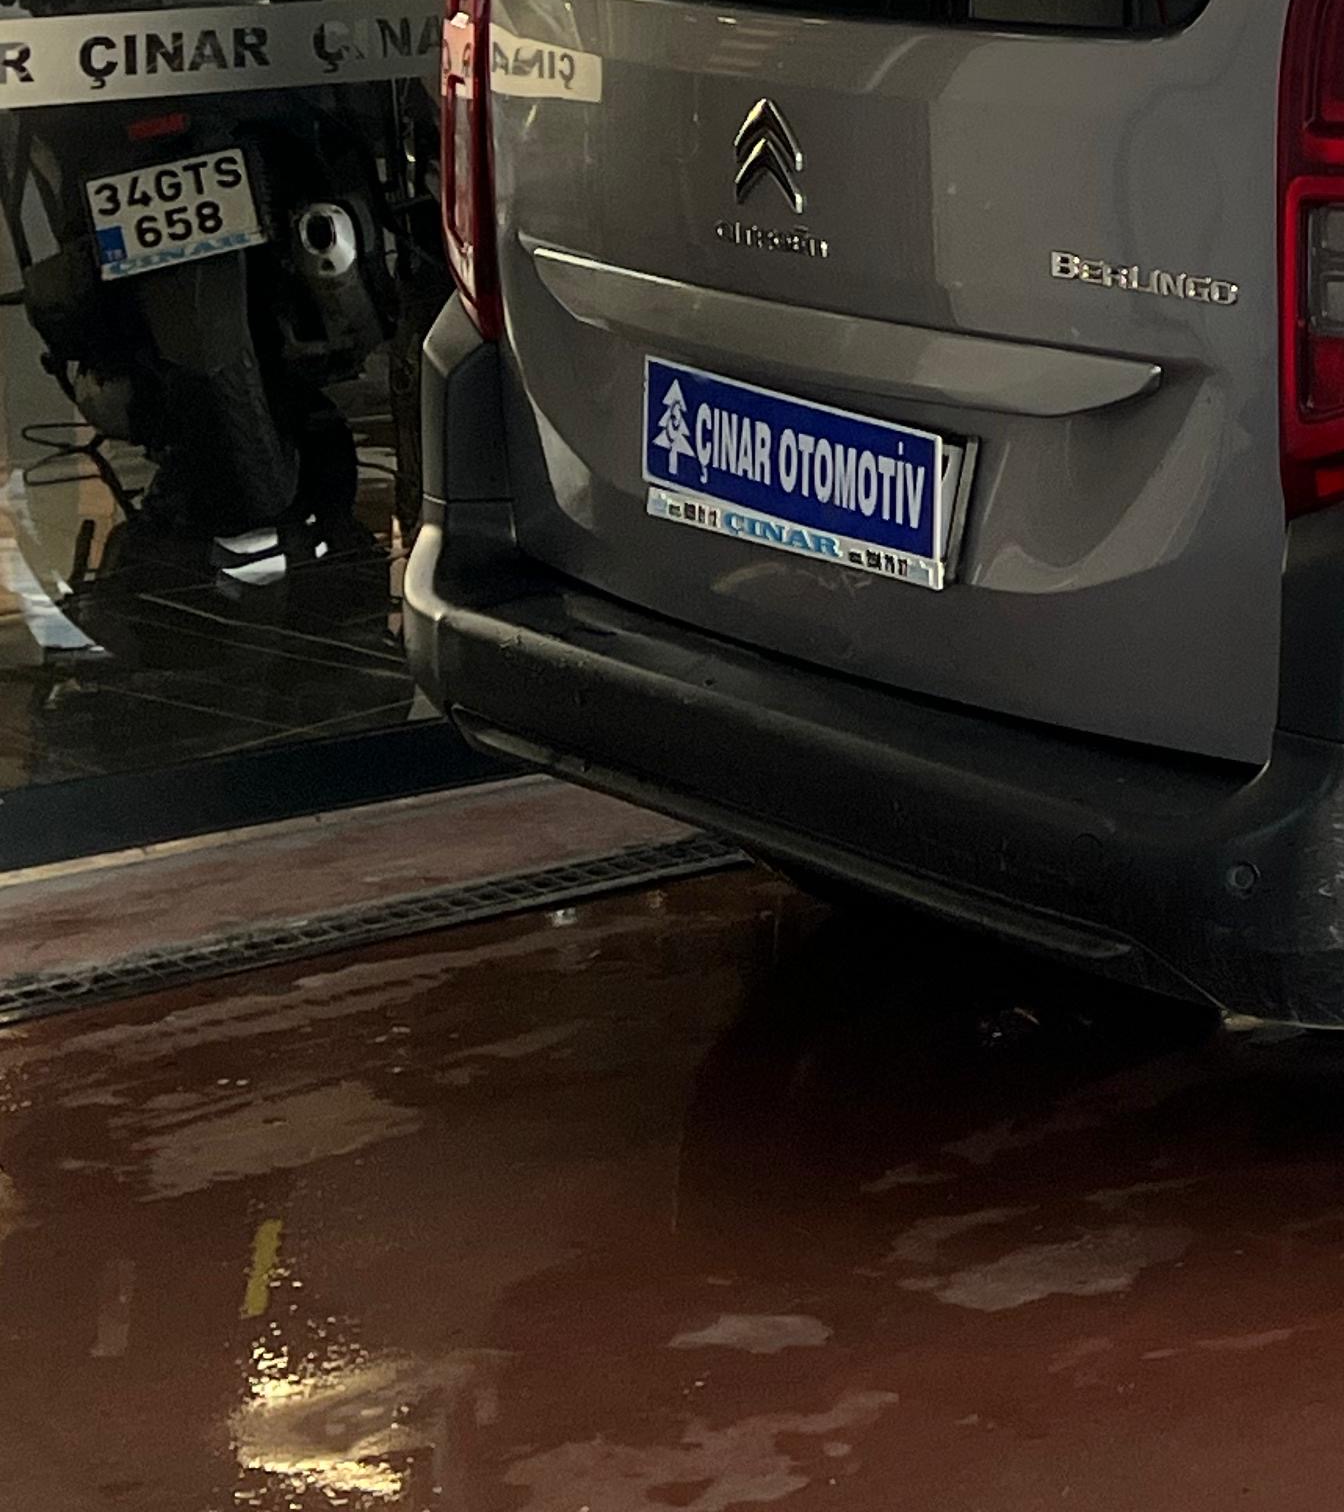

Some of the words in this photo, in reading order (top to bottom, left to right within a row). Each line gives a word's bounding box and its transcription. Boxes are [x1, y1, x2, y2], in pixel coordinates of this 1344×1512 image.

[79, 26, 270, 90] ÇINAR
[136, 201, 223, 248] 658
[1050, 250, 1239, 305] BERLINGO
[695, 402, 773, 483] ÇINAR
[778, 428, 926, 529] OTOMOTİV
[723, 511, 841, 558] ÇINAR
